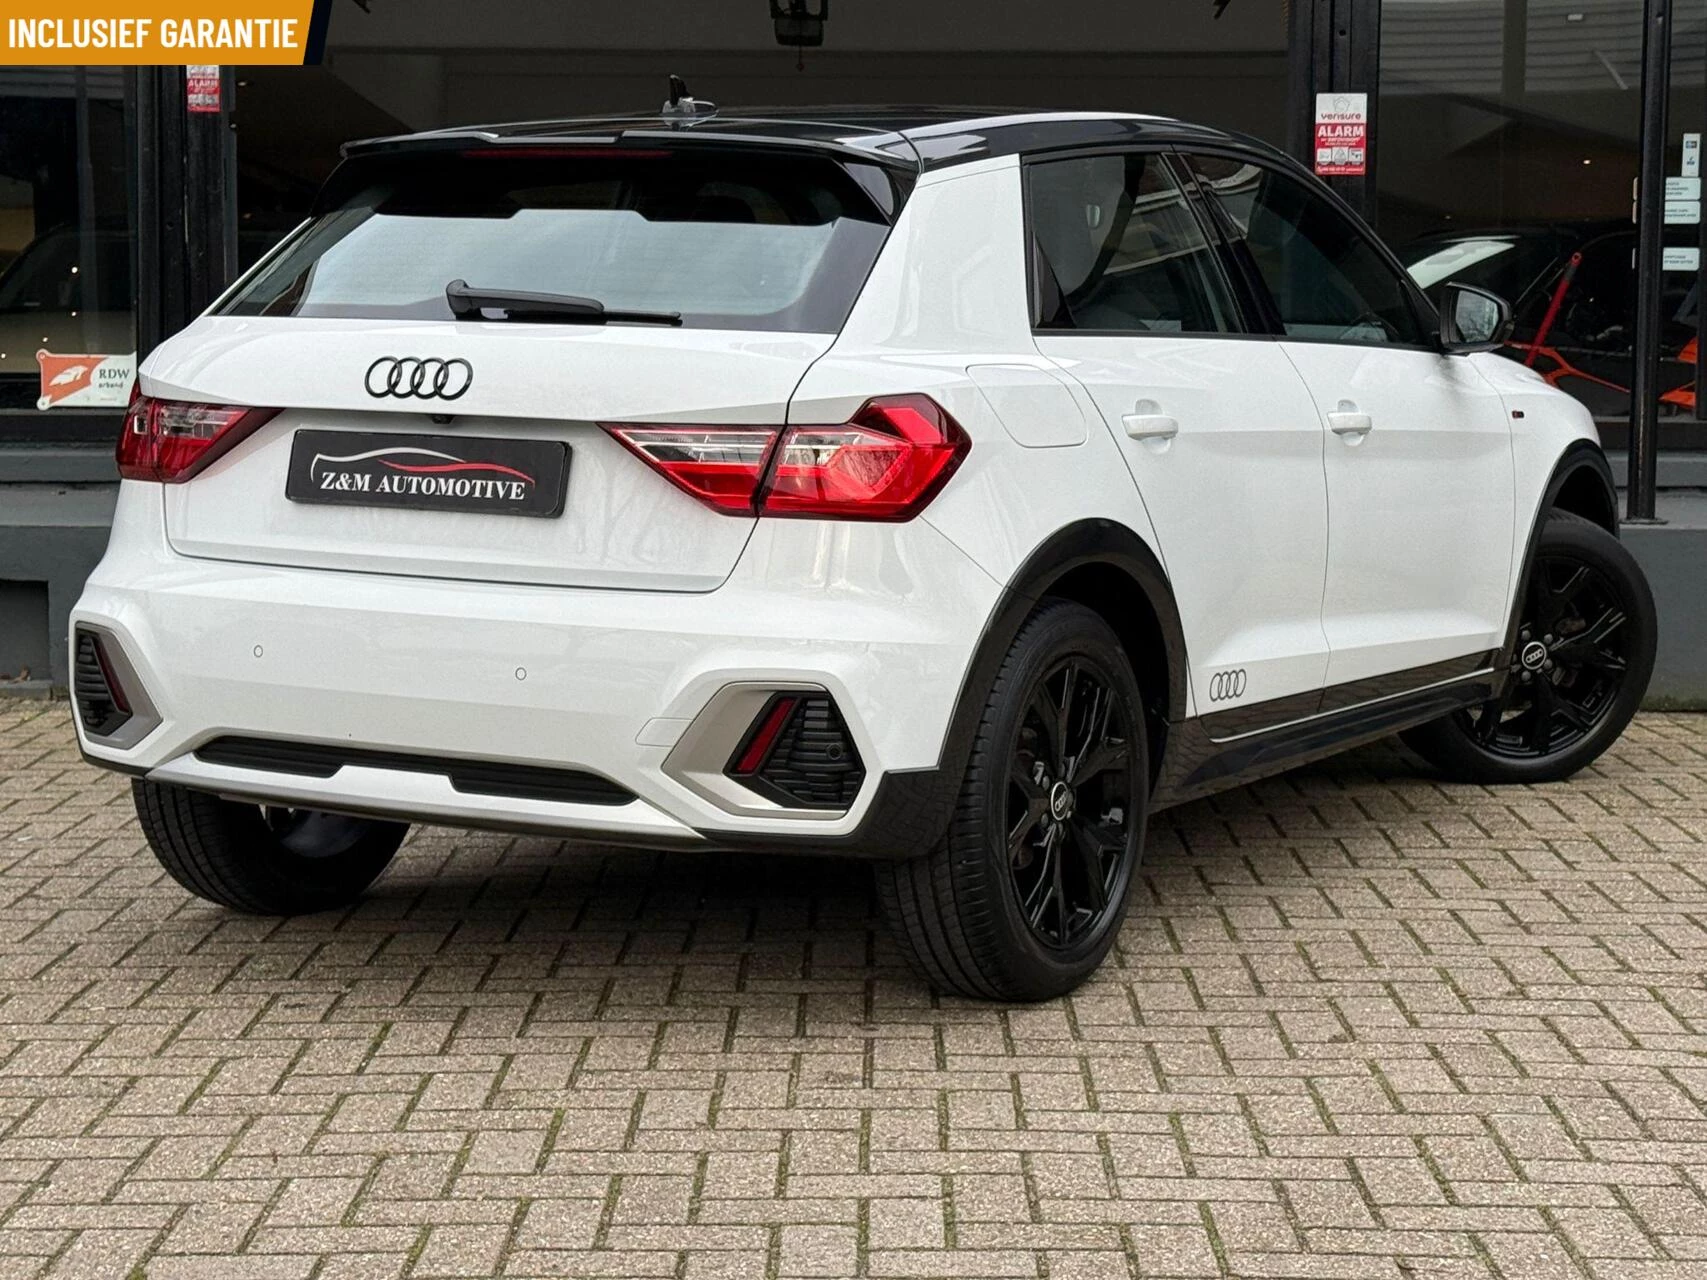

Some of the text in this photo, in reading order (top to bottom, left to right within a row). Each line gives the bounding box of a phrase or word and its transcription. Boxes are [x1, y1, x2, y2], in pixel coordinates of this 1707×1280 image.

[1318, 125, 1364, 138] ALARM
[98, 368, 130, 380] RDW
[320, 472, 525, 500] Z&M AUTOMOTIVE
